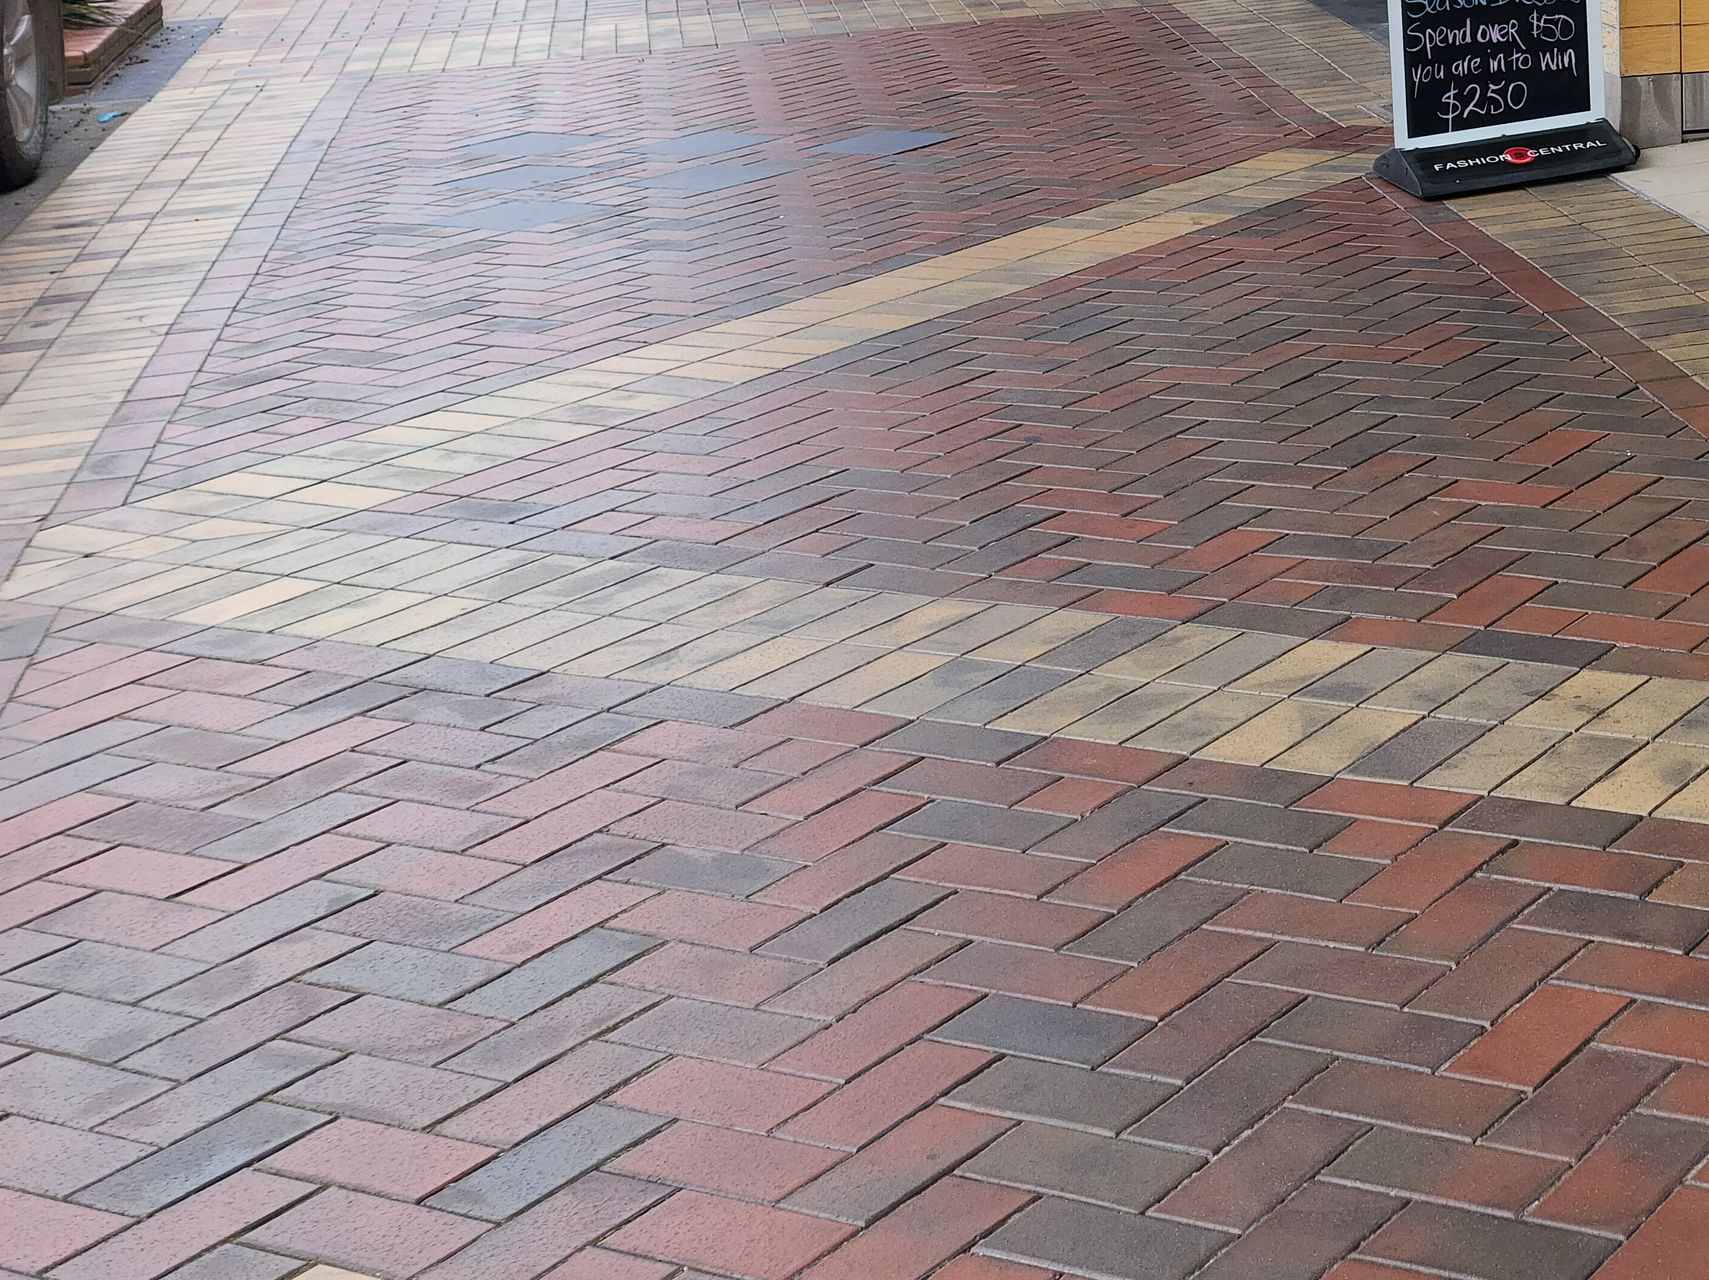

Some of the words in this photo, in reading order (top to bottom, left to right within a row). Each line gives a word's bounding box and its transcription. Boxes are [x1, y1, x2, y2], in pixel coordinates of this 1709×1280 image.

[1406, 17, 1472, 59] Spend
[1529, 9, 1575, 42] $50
[1411, 61, 1445, 99] you
[1452, 54, 1482, 77] are
[1488, 49, 1506, 74] in
[1436, 80, 1529, 133] $250
[1433, 152, 1512, 173] FASHION
[1526, 138, 1607, 159] CENTRAL
